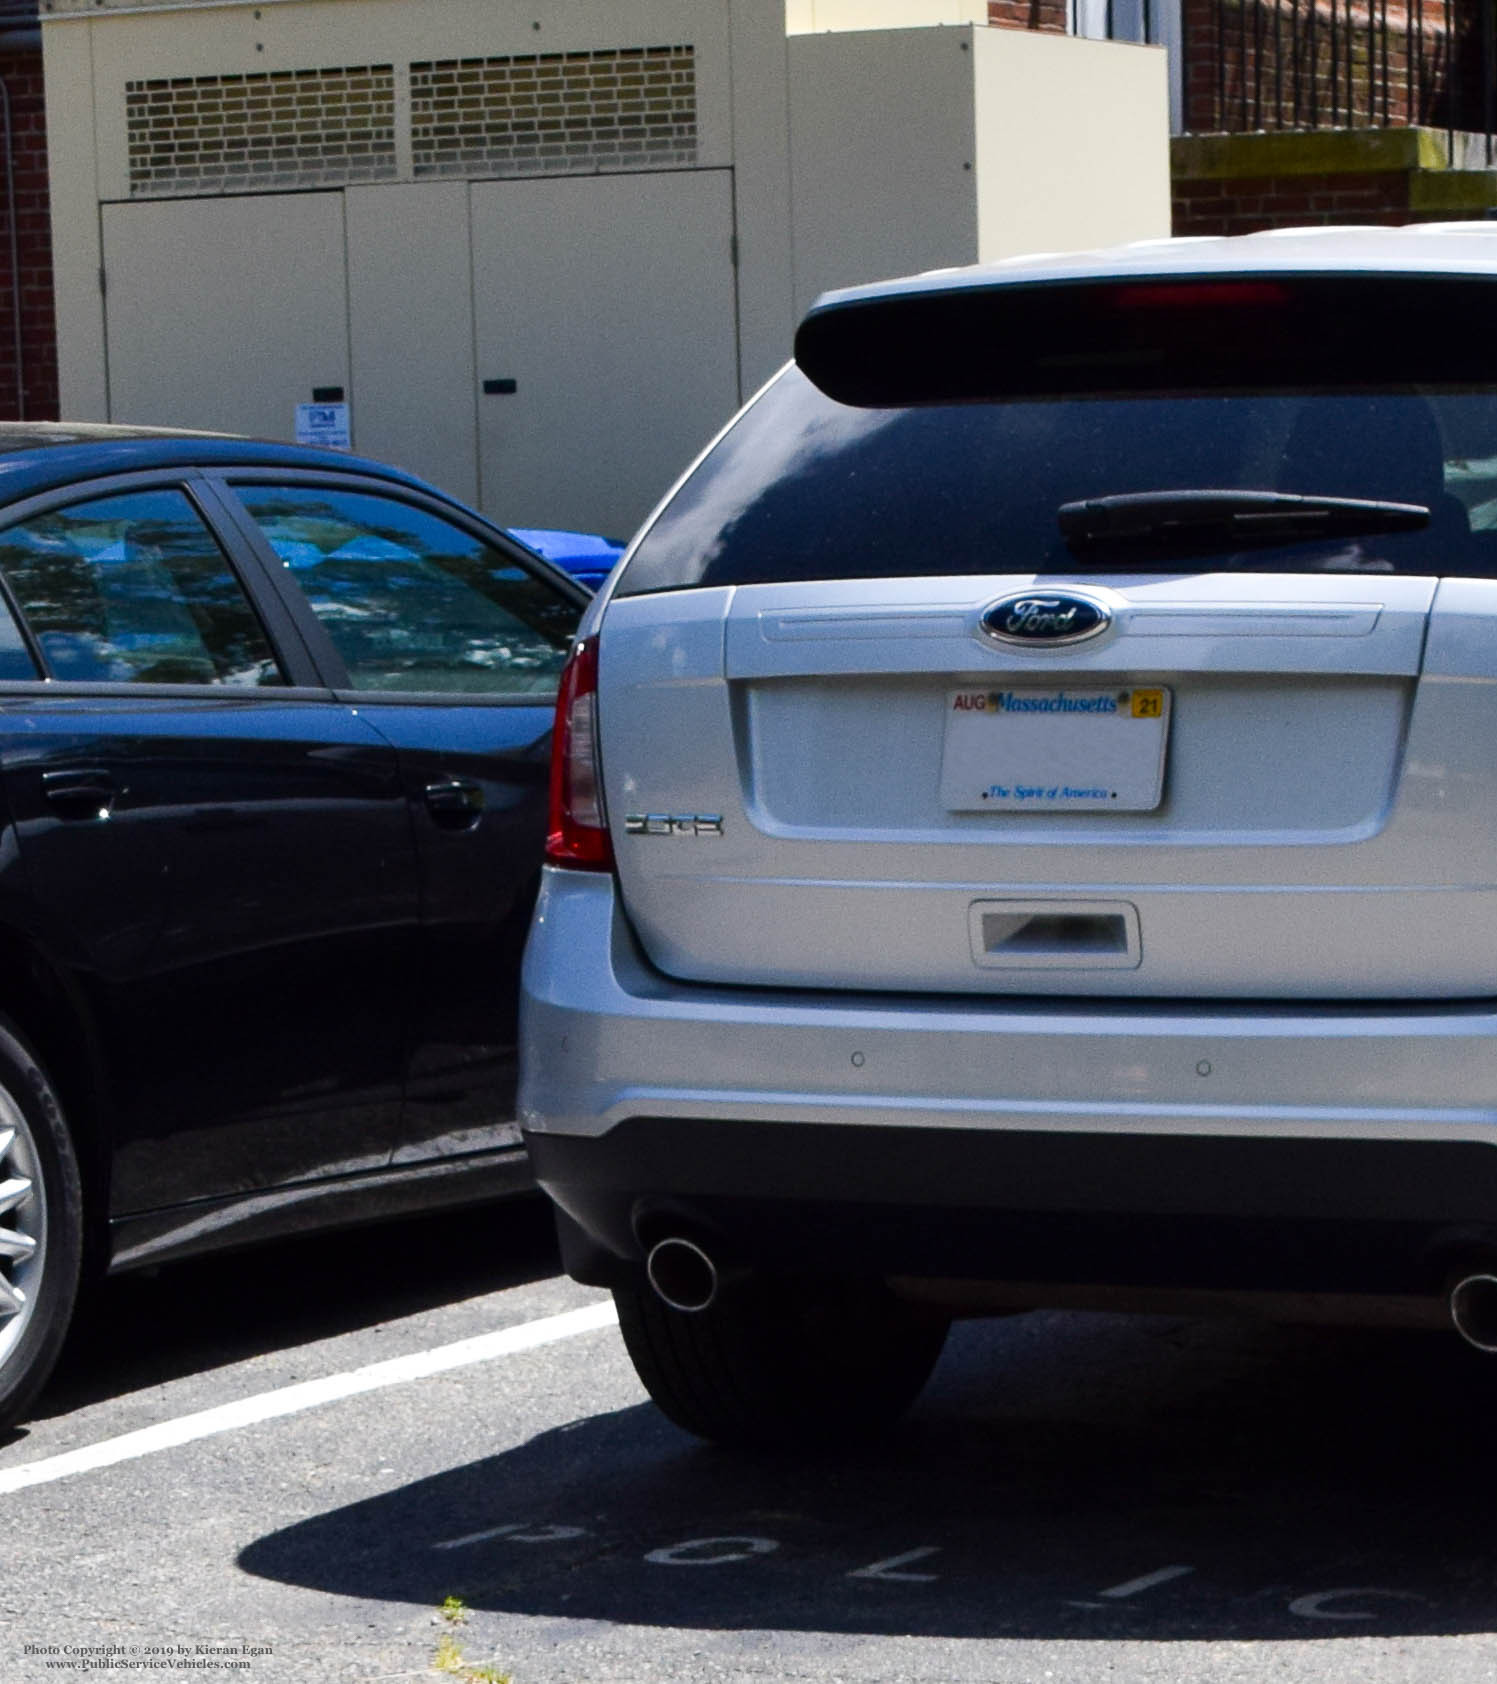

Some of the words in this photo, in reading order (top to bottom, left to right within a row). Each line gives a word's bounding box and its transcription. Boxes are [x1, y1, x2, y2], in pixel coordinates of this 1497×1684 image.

[1006, 599, 1077, 632] Ford
[953, 694, 986, 711] AUG
[997, 691, 1117, 714] Massachusetts
[1139, 698, 1158, 714] 21
[989, 785, 1009, 798] The
[1046, 786, 1058, 799] of
[1062, 786, 1108, 799] America
[624, 812, 724, 837] EDGE
